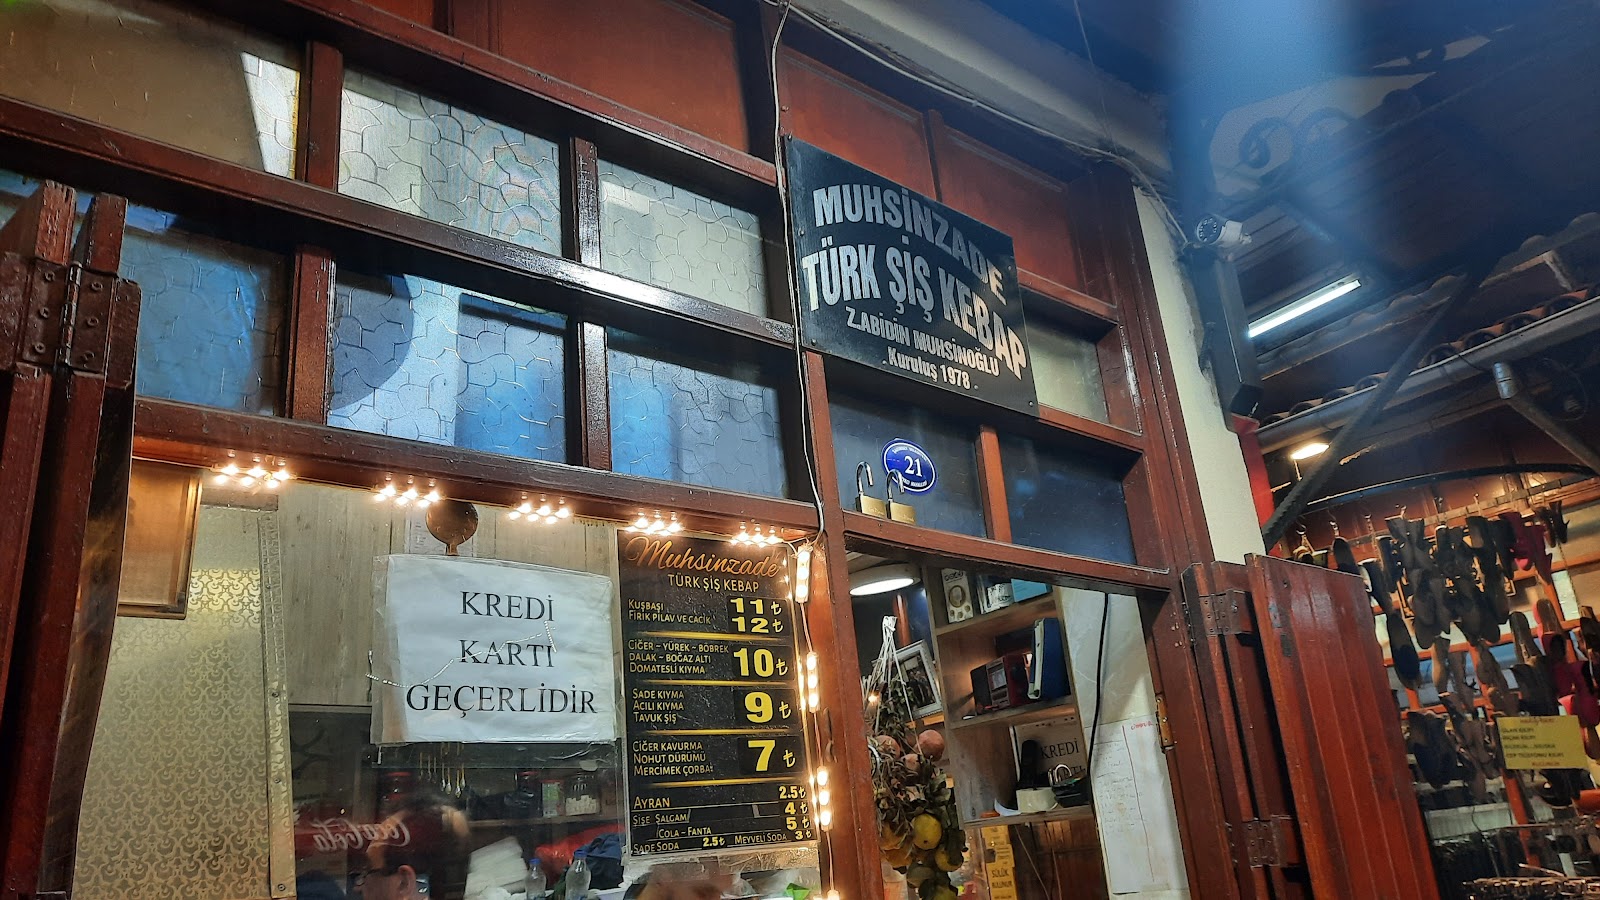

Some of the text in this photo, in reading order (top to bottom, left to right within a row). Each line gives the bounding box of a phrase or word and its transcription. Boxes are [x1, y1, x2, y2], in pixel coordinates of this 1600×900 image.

[813, 184, 1007, 306] MUHSİNZADE
[802, 235, 1027, 380] TÜRK ŞİŞ KEBAP
[913, 330, 1000, 377] MUHSİNOĞLU
[888, 346, 971, 390] Kuruluş 1978
[904, 455, 922, 477] 21
[626, 536, 780, 578] Muhsinzade
[667, 572, 759, 592] TÜRK ŞİŞ KEBAP
[459, 591, 555, 622] KREDİ
[628, 598, 664, 613] KUŞBAŞI
[677, 614, 687, 623] VE
[458, 639, 555, 667] KARTI
[628, 639, 654, 650] CİĞER
[663, 641, 690, 652] YÜREK
[629, 652, 656, 662] DALAK
[666, 652, 693, 663] BOĞAZ
[695, 655, 711, 663] ALTI
[629, 662, 706, 674] DOMATESLİ KIYMA
[406, 682, 598, 718] GEÇERLİDİR
[632, 688, 685, 699] SADE KIYMA
[633, 700, 655, 710] ACILI
[656, 701, 684, 710] KIYMA
[744, 691, 773, 723] 9
[633, 711, 677, 724] TAVUK ŞİŞ
[632, 740, 703, 752] CİĞER KAVURMA
[633, 753, 666, 764] NOHUT
[668, 750, 706, 763] DÜRÜMÜ
[748, 740, 776, 772] 7
[1040, 737, 1080, 759] KREDİ
[634, 763, 681, 776] MERCİMEK
[633, 796, 671, 809] AYRAN
[785, 801, 796, 815] 4
[658, 828, 680, 838] COLA
[687, 826, 712, 836] FANTA
[786, 817, 797, 830] 5
[633, 843, 656, 853] SADE
[656, 841, 680, 851] SODA
[734, 831, 766, 844] MEYVELİ
[767, 832, 787, 842] SODA
[795, 830, 803, 840] 3
